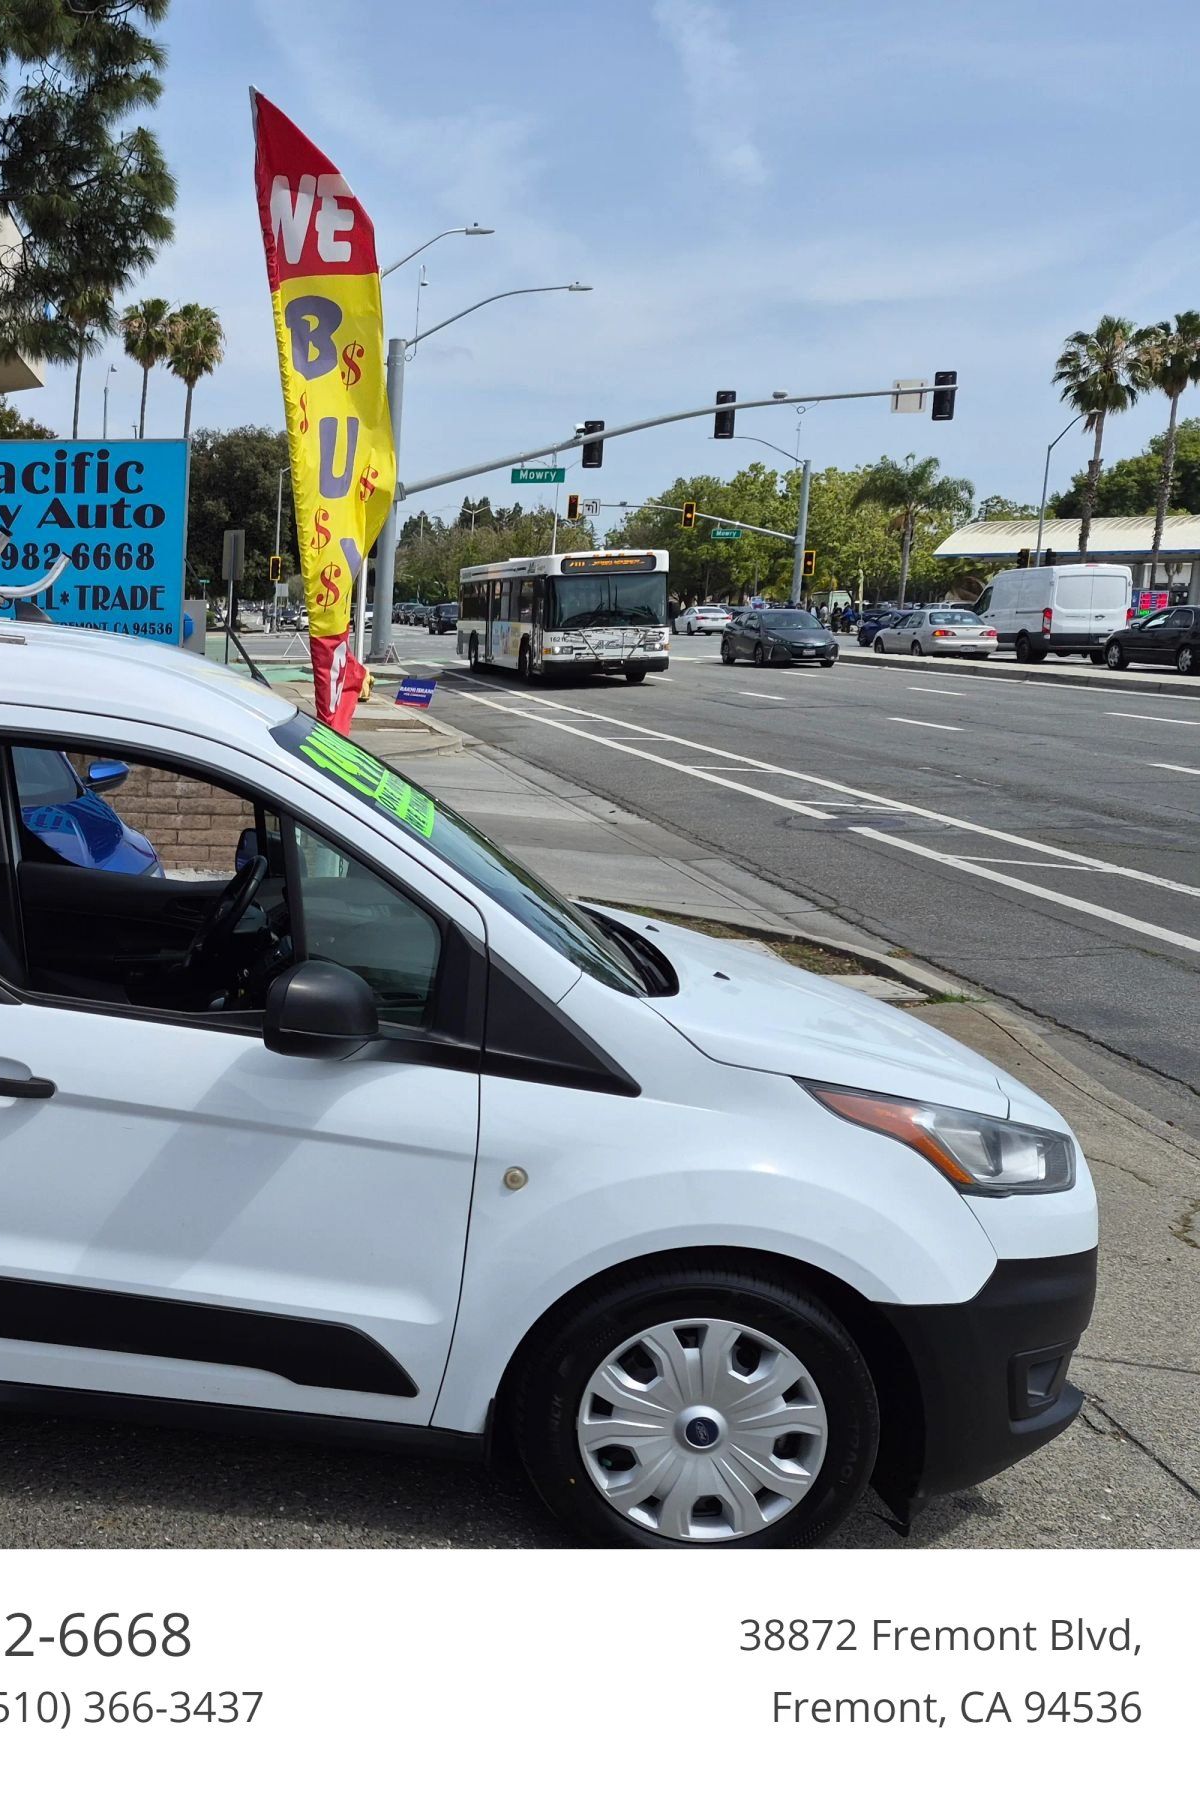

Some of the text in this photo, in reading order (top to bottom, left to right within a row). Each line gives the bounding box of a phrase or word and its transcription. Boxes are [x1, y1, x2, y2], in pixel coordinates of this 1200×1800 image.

[270, 173, 355, 265] WE
[519, 469, 557, 482] Mowry
[36, 497, 166, 529] Auto
[716, 530, 737, 538] Mowry
[74, 585, 166, 611] TRADE
[113, 622, 129, 634] CA
[133, 622, 173, 635] 94536
